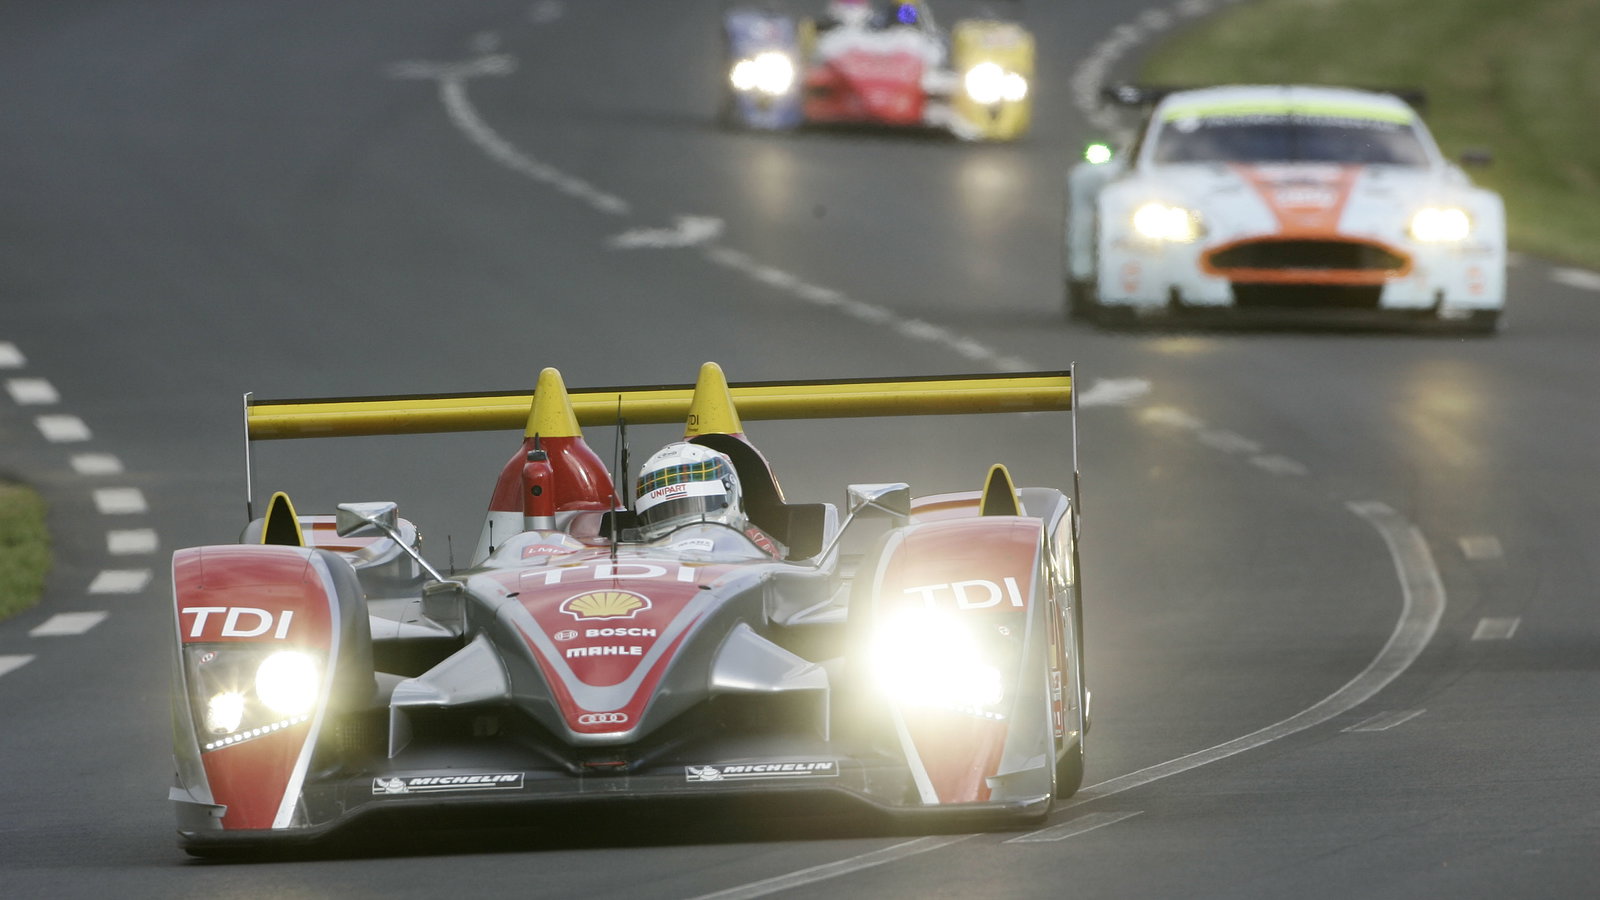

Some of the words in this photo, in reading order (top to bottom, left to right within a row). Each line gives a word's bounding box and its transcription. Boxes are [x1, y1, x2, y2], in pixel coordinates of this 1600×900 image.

[650, 484, 686, 499] UNIPART
[521, 564, 695, 585] TDI
[904, 577, 1024, 611] TDI
[182, 606, 294, 640] TDI
[585, 628, 656, 638] BOSCH
[566, 646, 642, 658] MAHLE
[723, 762, 832, 773] MICHELIN
[409, 774, 519, 786] MICHELIN
